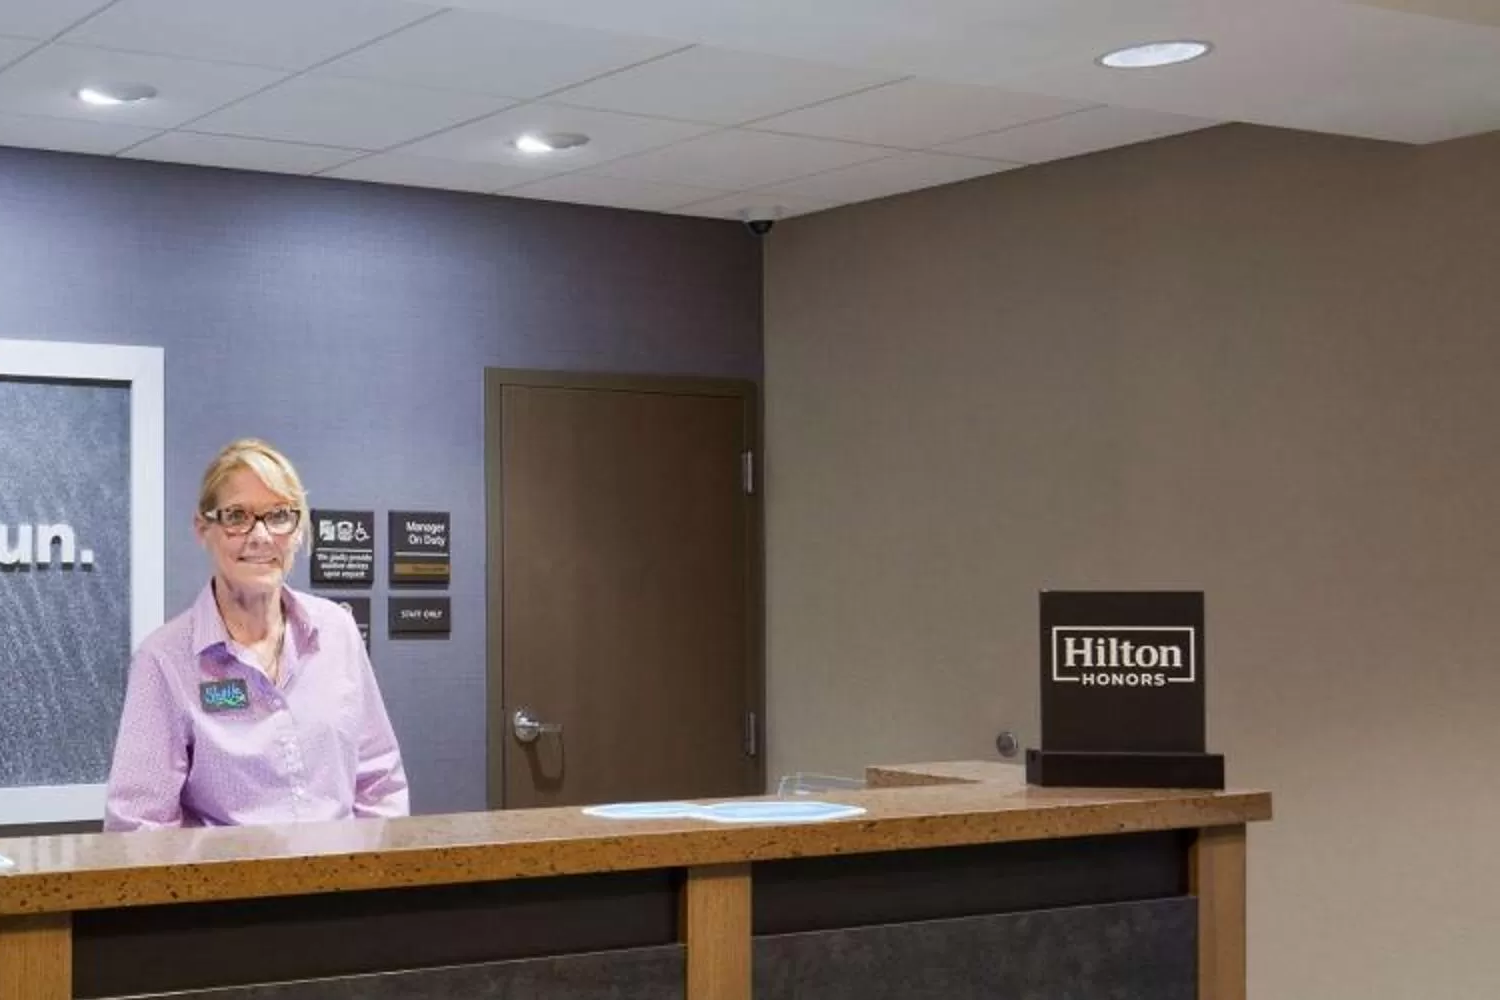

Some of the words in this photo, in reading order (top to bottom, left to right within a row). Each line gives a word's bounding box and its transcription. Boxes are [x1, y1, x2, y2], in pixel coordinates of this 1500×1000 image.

[405, 521, 445, 535] Manager
[408, 534, 423, 545] On
[423, 535, 446, 547] Duty
[1063, 637, 1183, 668] Hilton
[1082, 672, 1166, 687] HONORS
